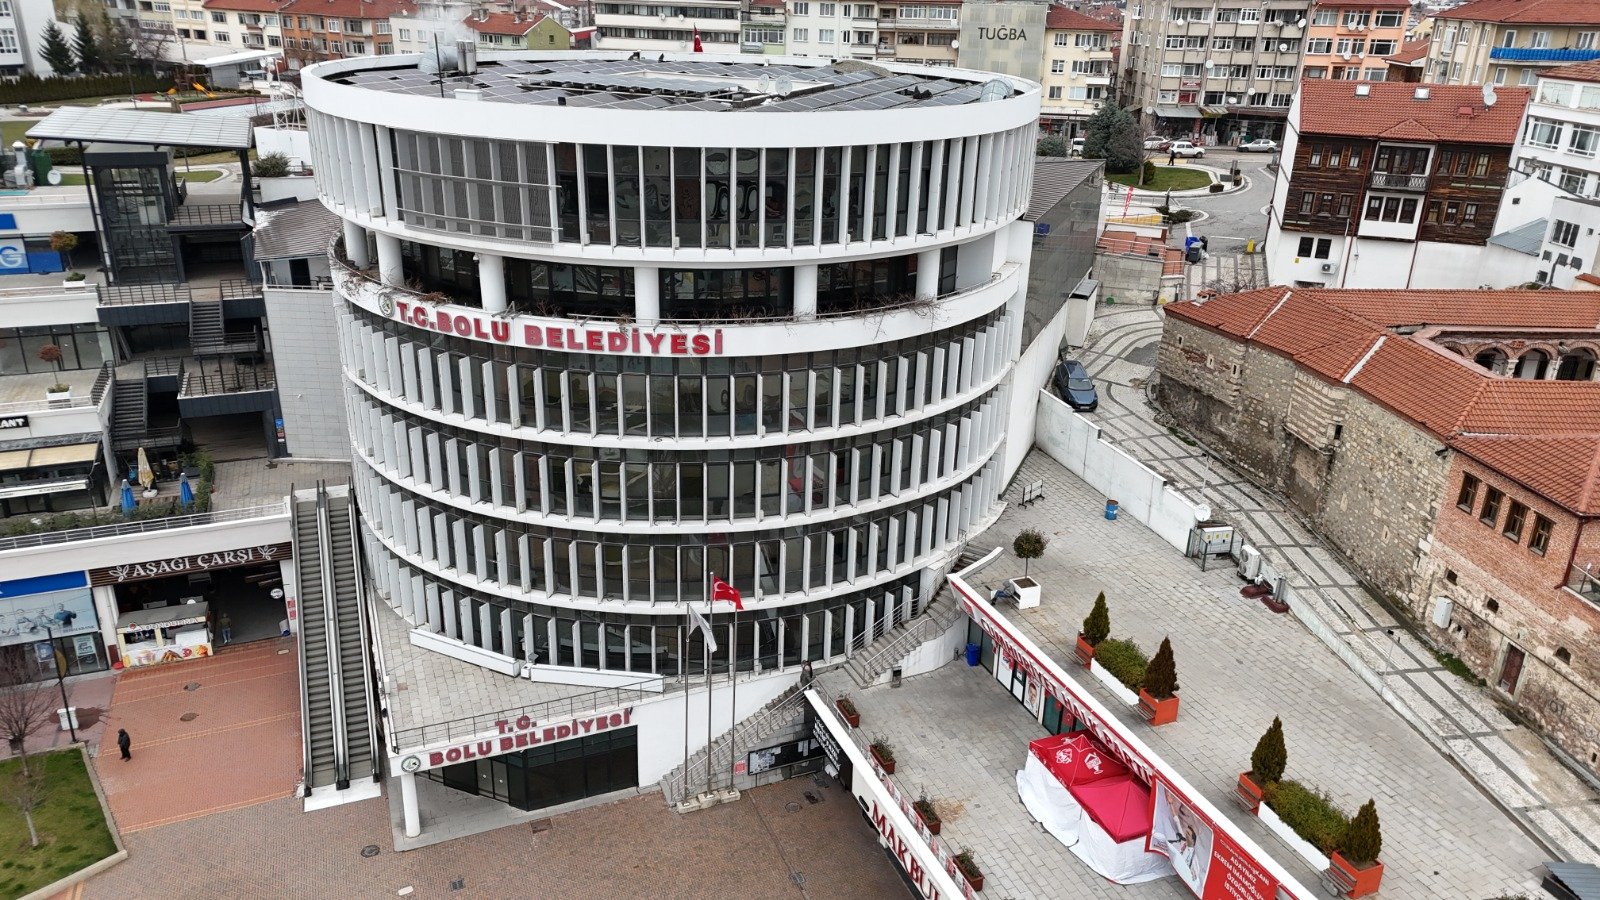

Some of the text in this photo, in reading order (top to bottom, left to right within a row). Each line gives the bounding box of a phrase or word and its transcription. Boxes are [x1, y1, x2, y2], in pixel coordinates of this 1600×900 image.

[978, 25, 1027, 41] TUĞBA
[524, 323, 723, 355] BELEDİYESİ
[132, 548, 254, 577] AŞAĞI ÇARŞI
[429, 707, 631, 767] BOLU BELEDİYESİ
[1061, 691, 1100, 737] HALK
[1103, 729, 1153, 785] PARTİ
